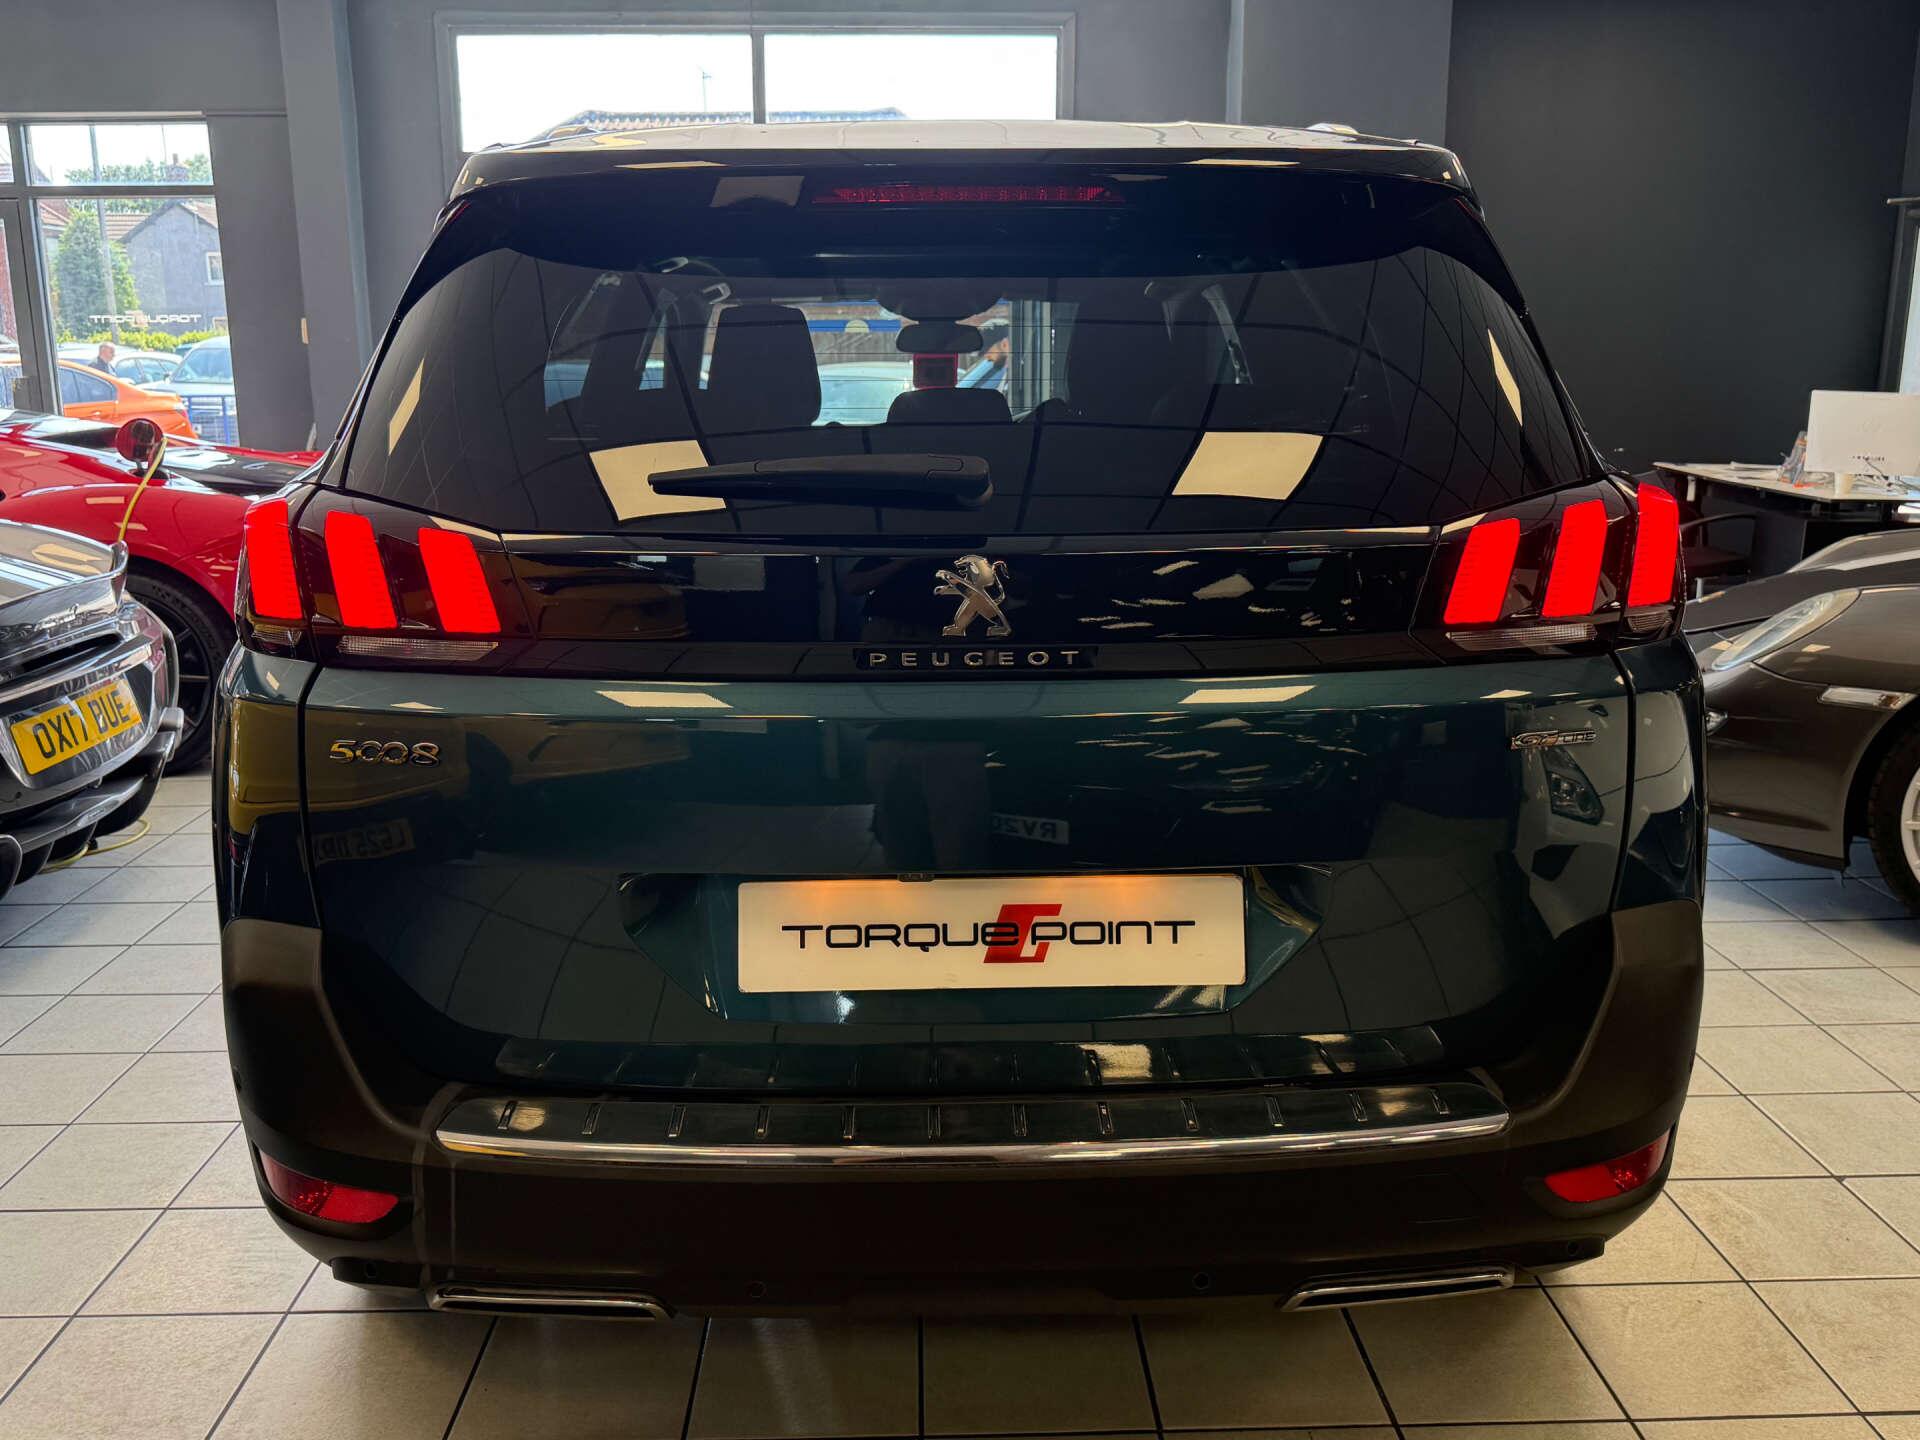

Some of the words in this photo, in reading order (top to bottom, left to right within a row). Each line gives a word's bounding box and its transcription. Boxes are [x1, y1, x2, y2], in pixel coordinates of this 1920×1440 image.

[869, 651, 1080, 667] PEUGEOT
[32, 702, 89, 759] OX17
[87, 689, 131, 734] BUE
[329, 740, 440, 767] 5008
[781, 922, 1020, 953] TORQUE
[1030, 920, 1196, 947] POINT
